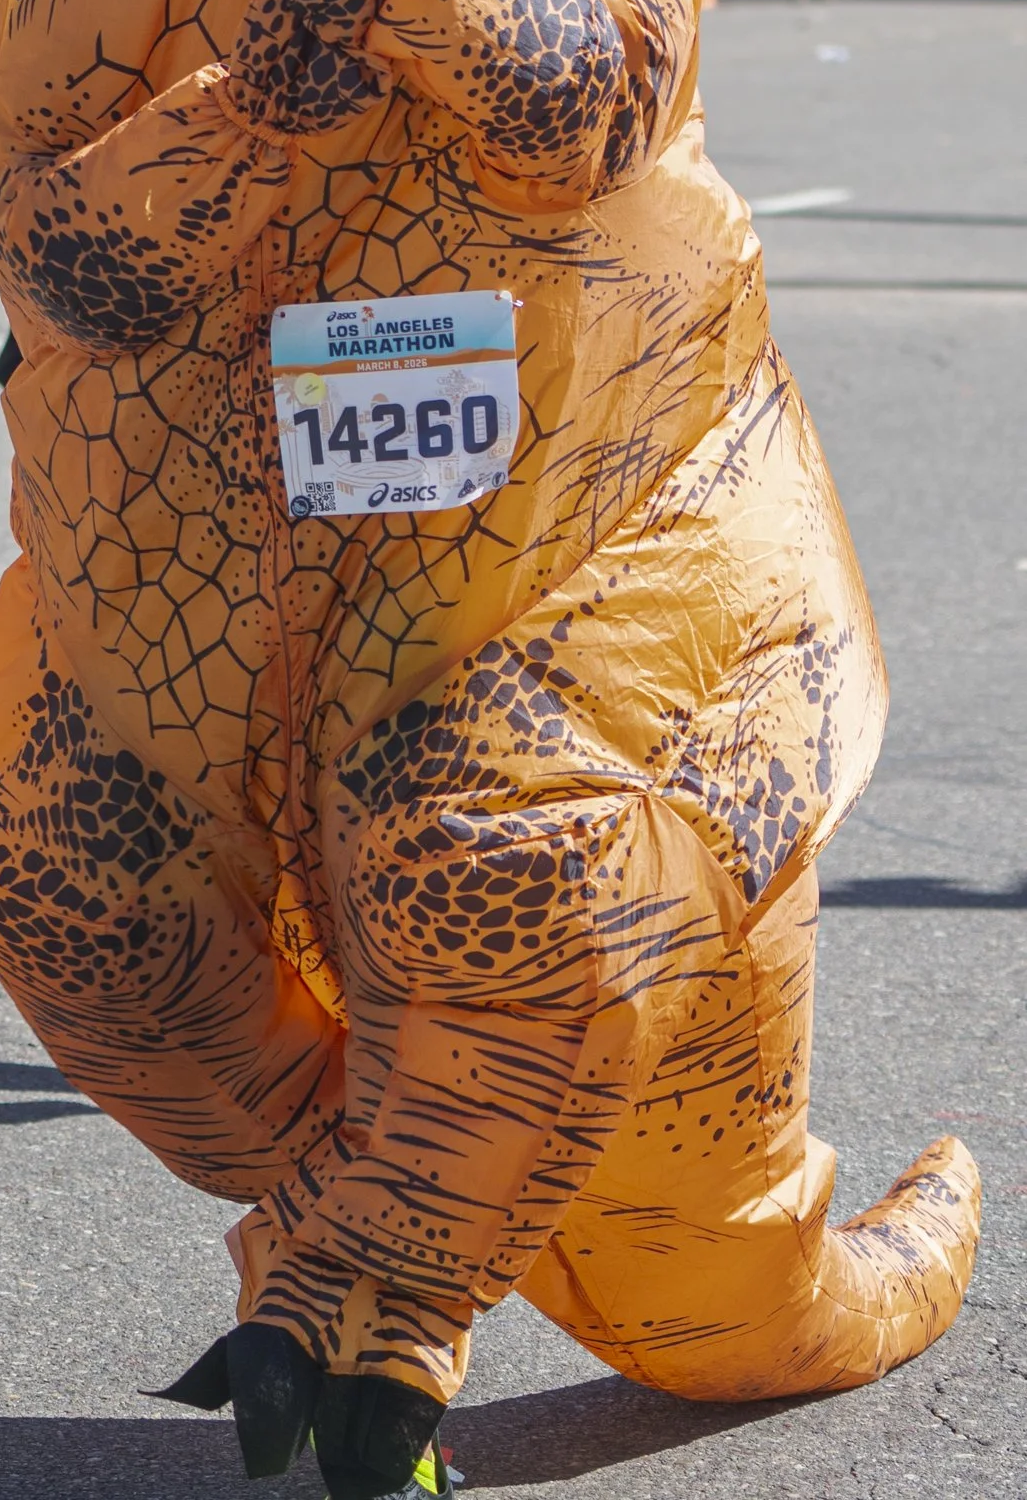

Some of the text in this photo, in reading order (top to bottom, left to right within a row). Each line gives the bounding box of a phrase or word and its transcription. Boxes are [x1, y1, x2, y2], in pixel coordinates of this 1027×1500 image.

[327, 317, 454, 338] LOS ANGELES
[329, 333, 455, 357] MARATHON
[356, 358, 428, 372] MARCH 8, 2026
[294, 395, 499, 465] 14260
